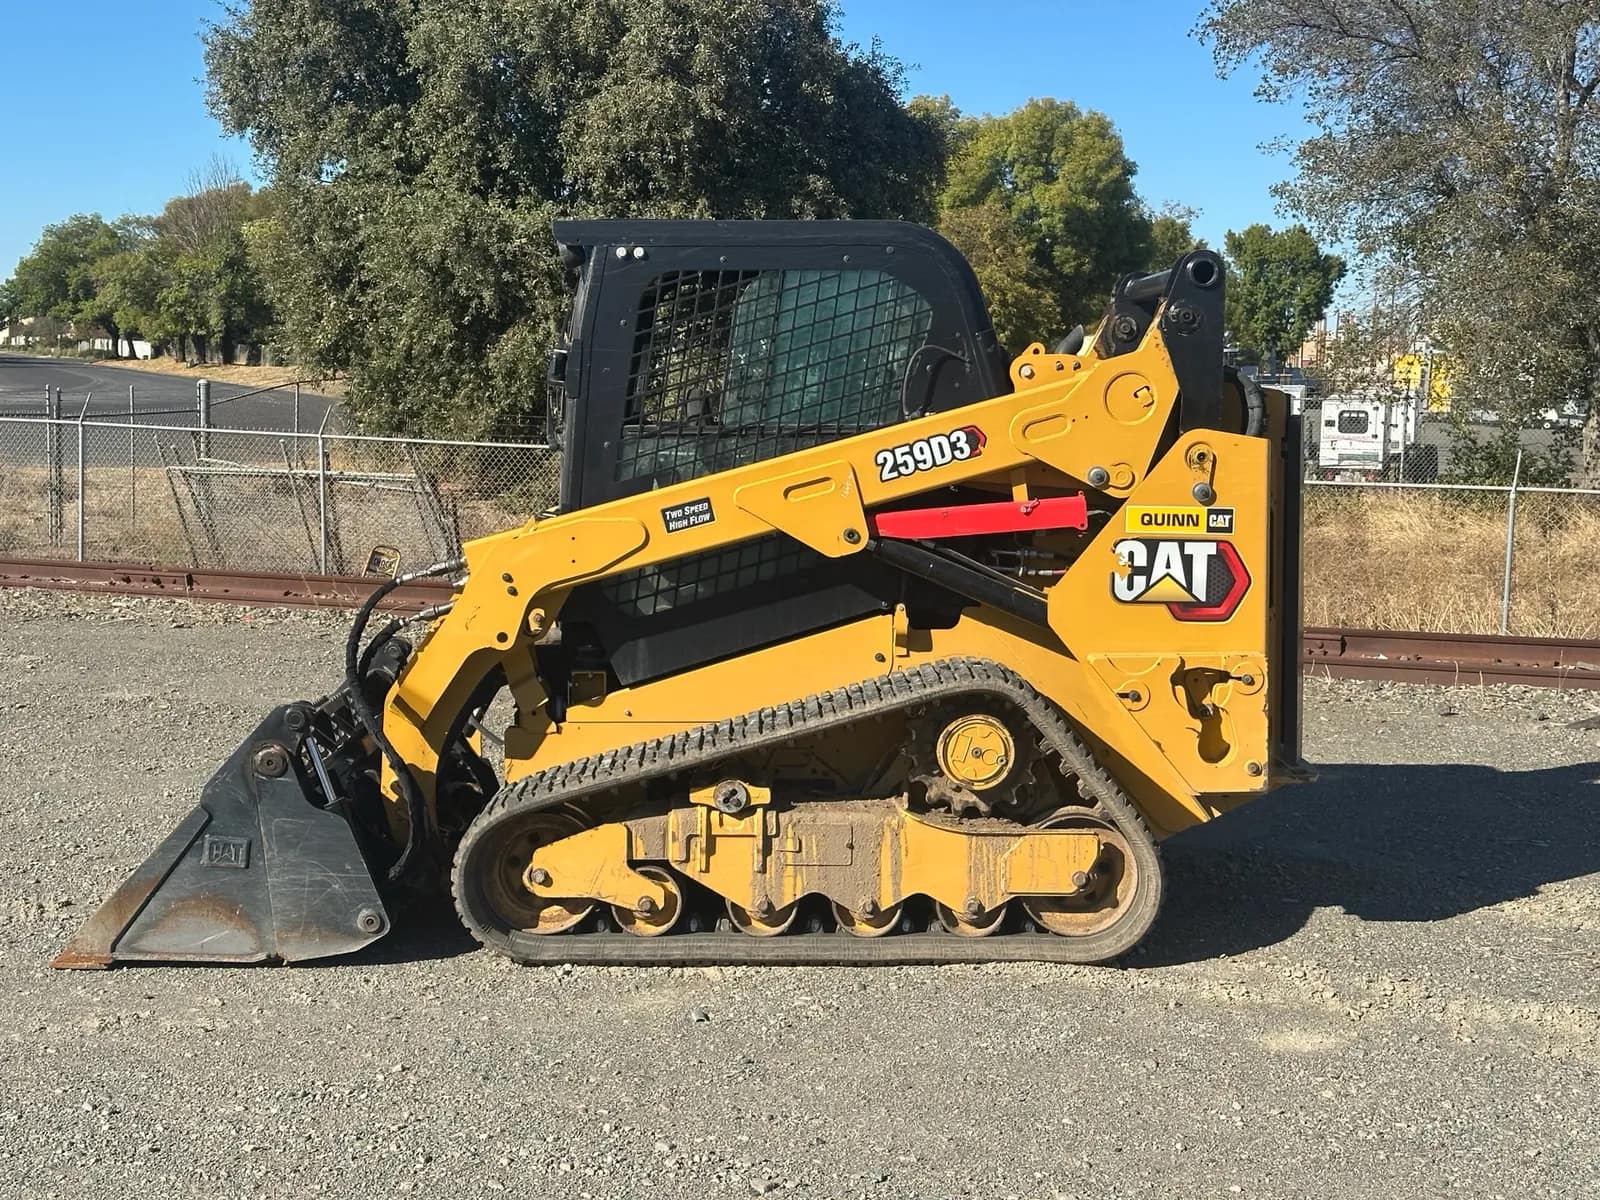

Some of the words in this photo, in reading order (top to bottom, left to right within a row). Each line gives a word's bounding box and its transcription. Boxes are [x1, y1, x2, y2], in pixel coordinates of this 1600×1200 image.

[876, 429, 971, 482] 259D3
[1140, 512, 1200, 527] QUINN
[1209, 514, 1232, 528] CAT
[1113, 539, 1217, 602] CAT
[208, 841, 244, 865] CAT
